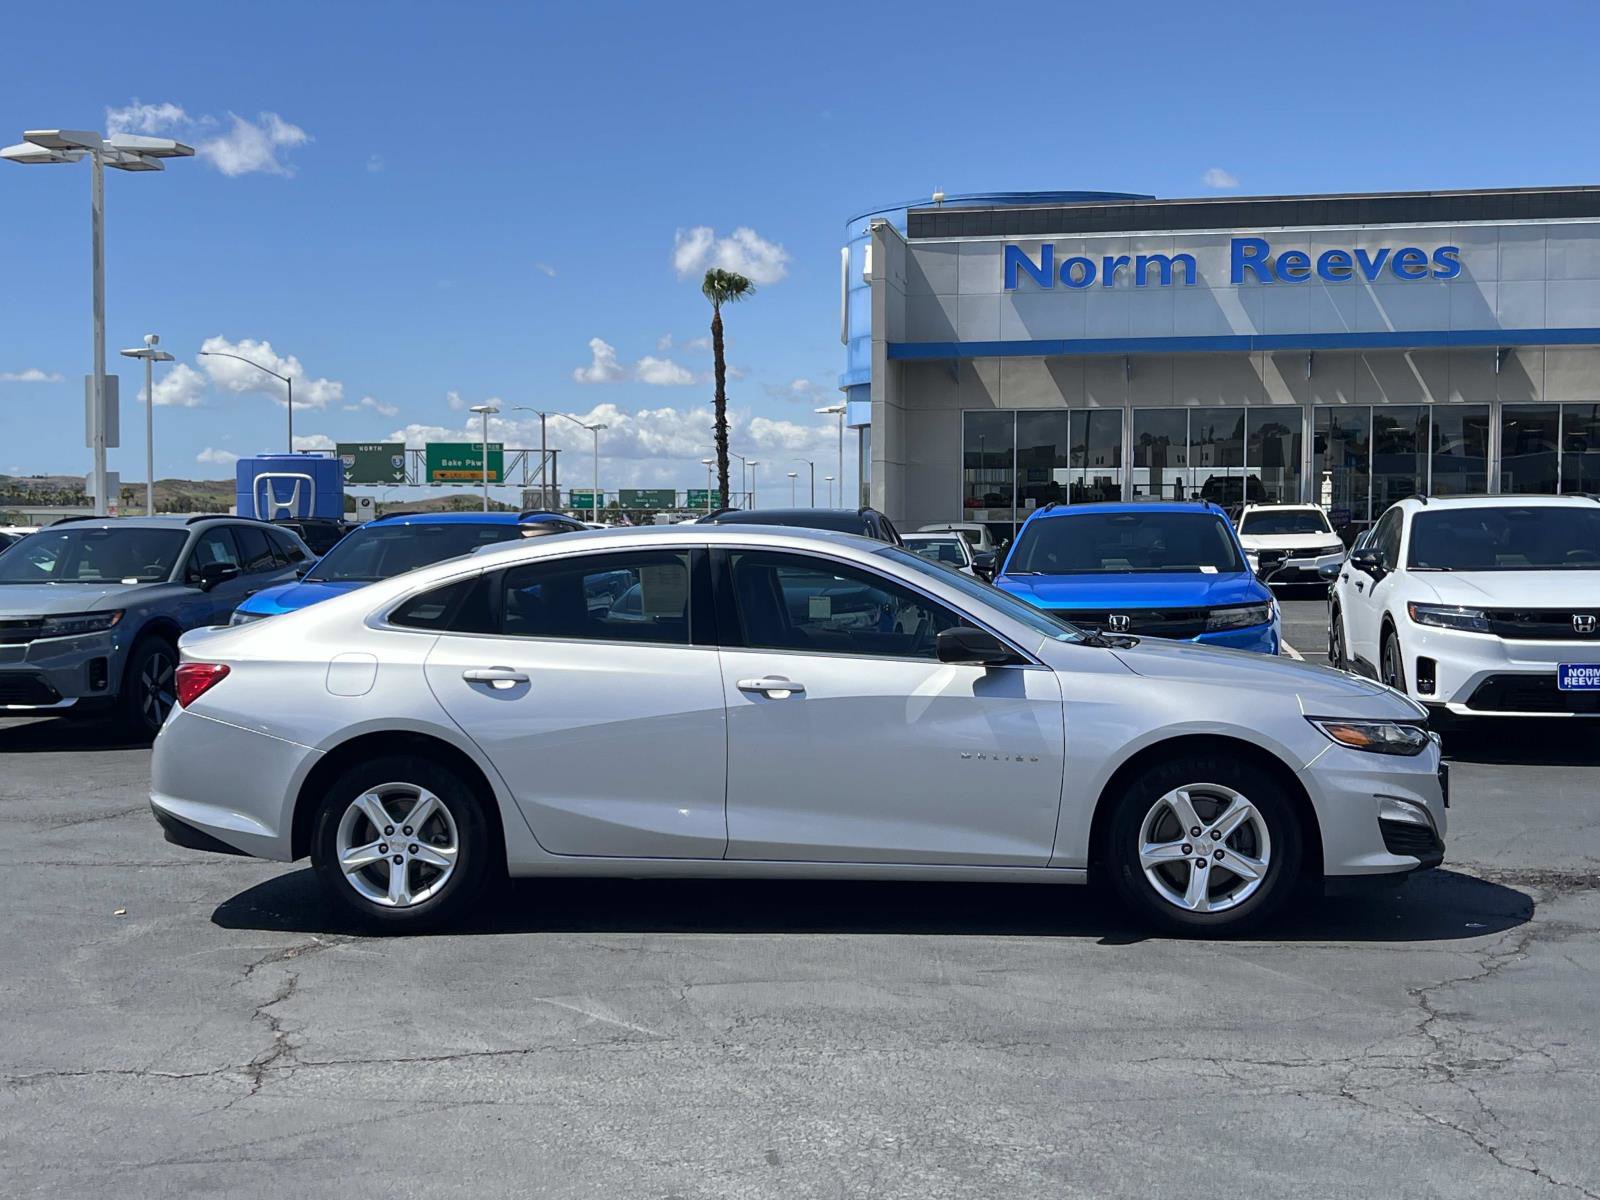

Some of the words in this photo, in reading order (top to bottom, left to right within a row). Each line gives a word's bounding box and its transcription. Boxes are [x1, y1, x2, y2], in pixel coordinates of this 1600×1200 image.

[1003, 243, 1197, 291] Norm
[1230, 237, 1462, 285] Reeves
[441, 459, 462, 467] Bake
[465, 459, 485, 467] Pkw
[1568, 668, 1600, 677] NORM
[1563, 677, 1600, 686] REEVE
